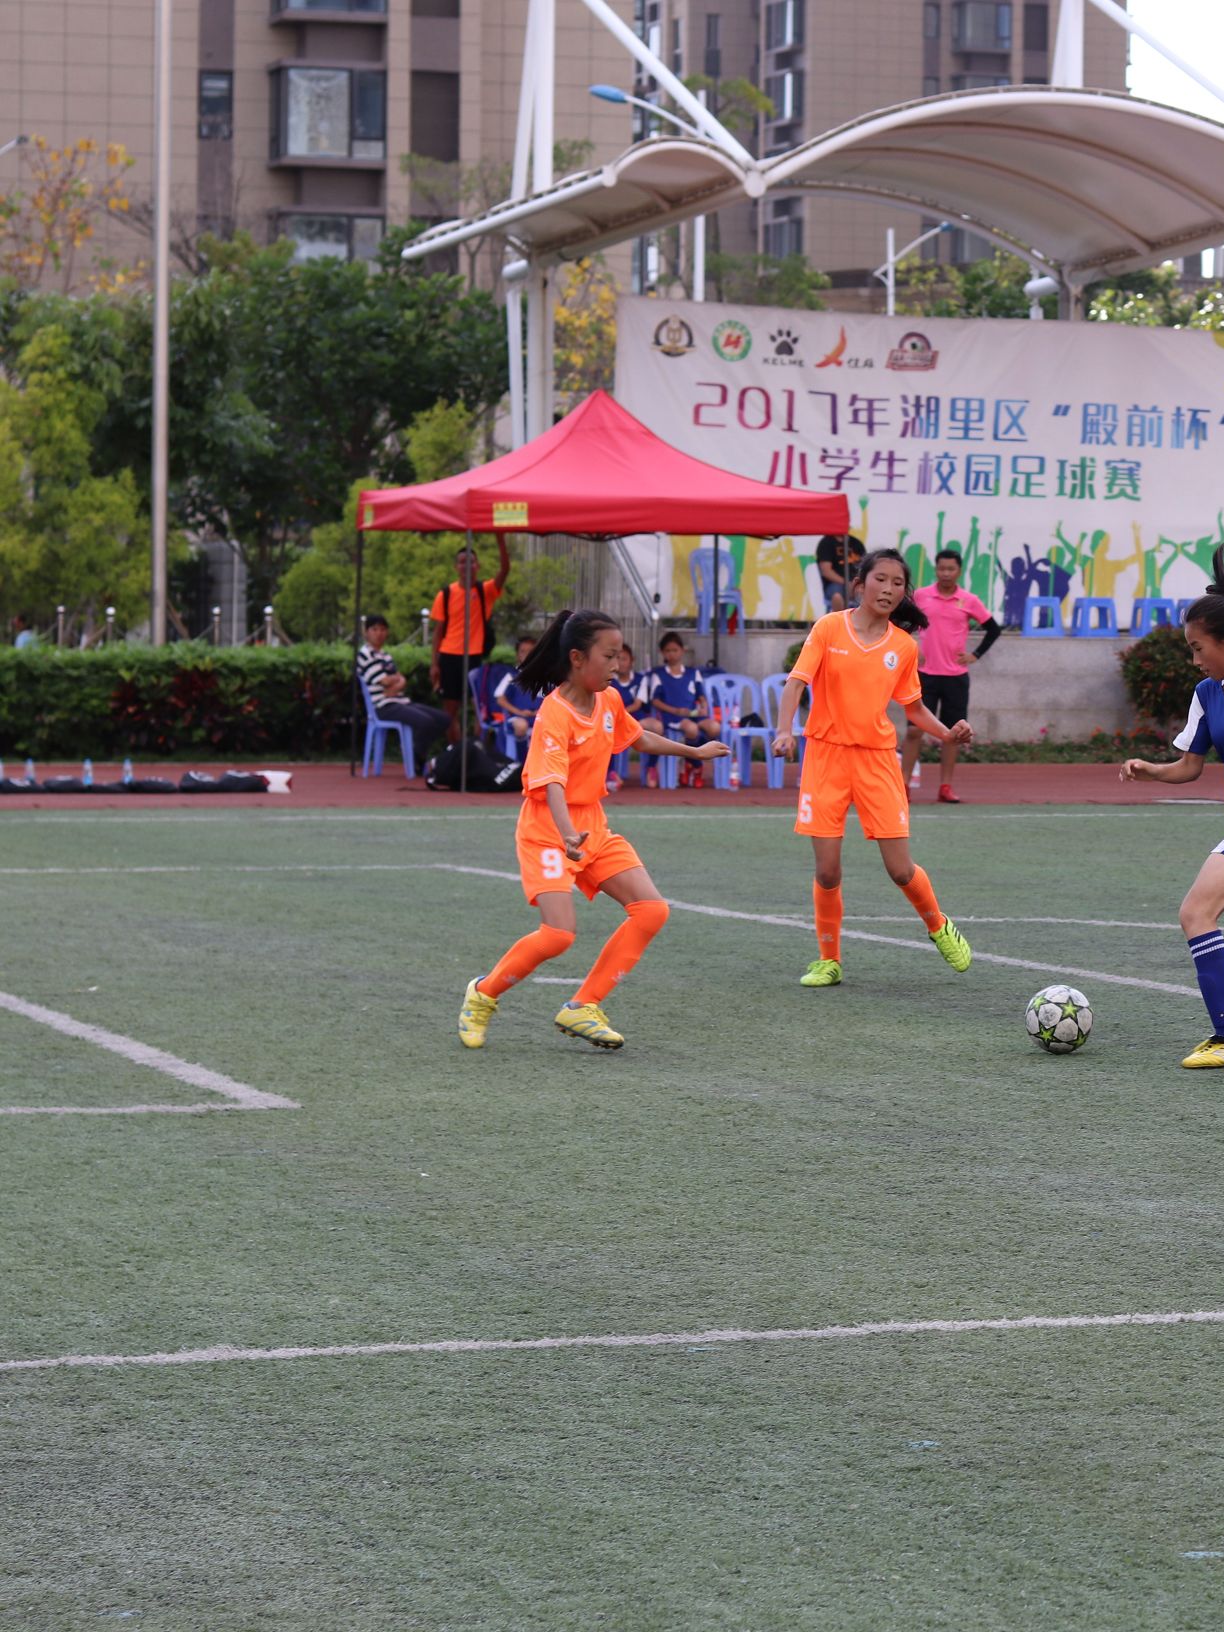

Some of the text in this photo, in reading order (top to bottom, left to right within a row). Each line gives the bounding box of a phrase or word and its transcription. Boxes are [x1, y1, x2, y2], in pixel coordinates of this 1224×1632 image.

[767, 444, 1143, 502] 小学生校园足球赛
[800, 792, 812, 823] 5
[541, 848, 563, 879] 9
